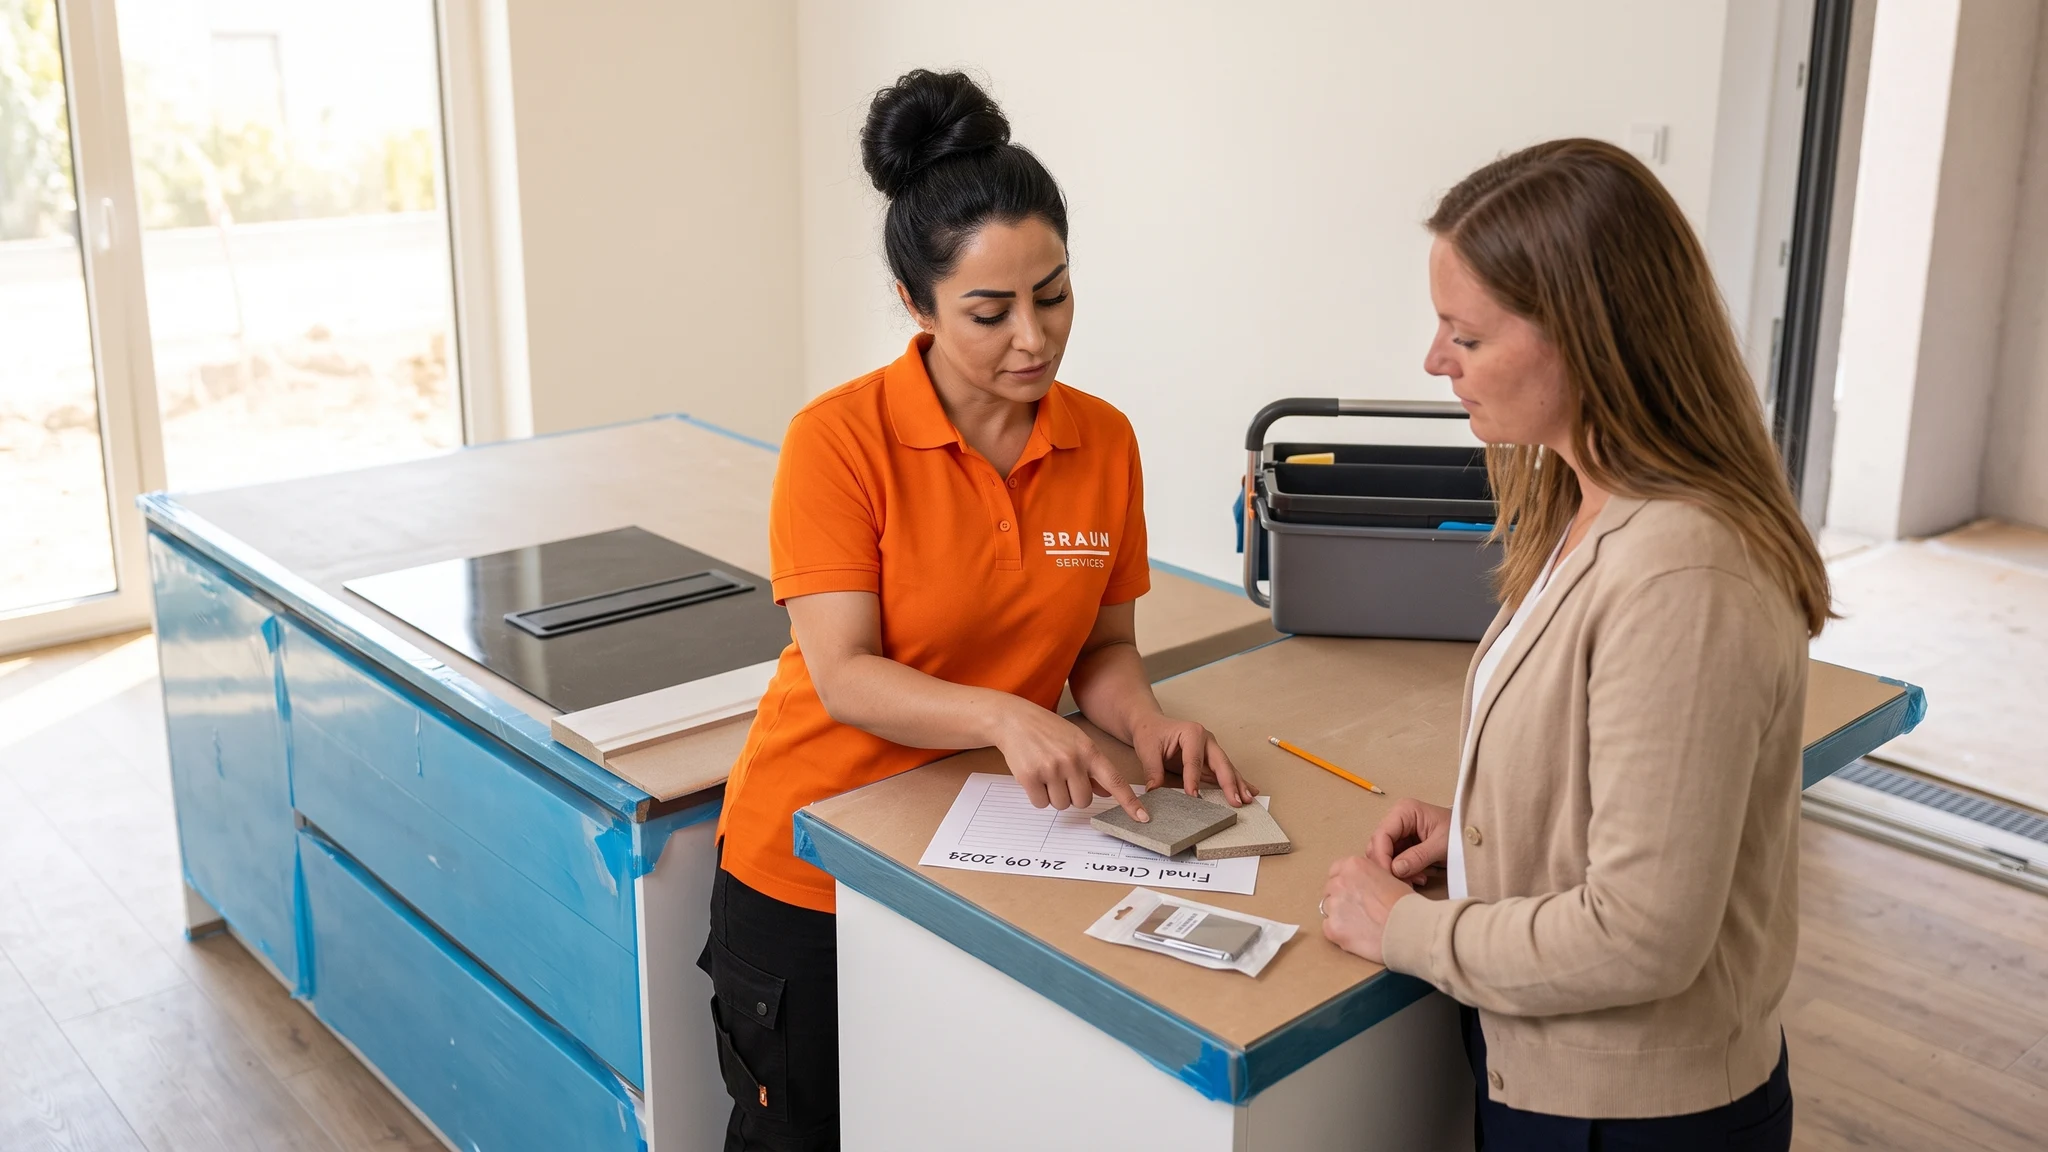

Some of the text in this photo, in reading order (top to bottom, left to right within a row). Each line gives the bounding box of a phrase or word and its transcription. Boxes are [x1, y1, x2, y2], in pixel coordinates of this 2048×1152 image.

[1042, 531, 1110, 548] BRAUN
[1055, 558, 1104, 568] SERVICES
[1084, 861, 1150, 878] Clean:
[1158, 869, 1211, 883] Final
